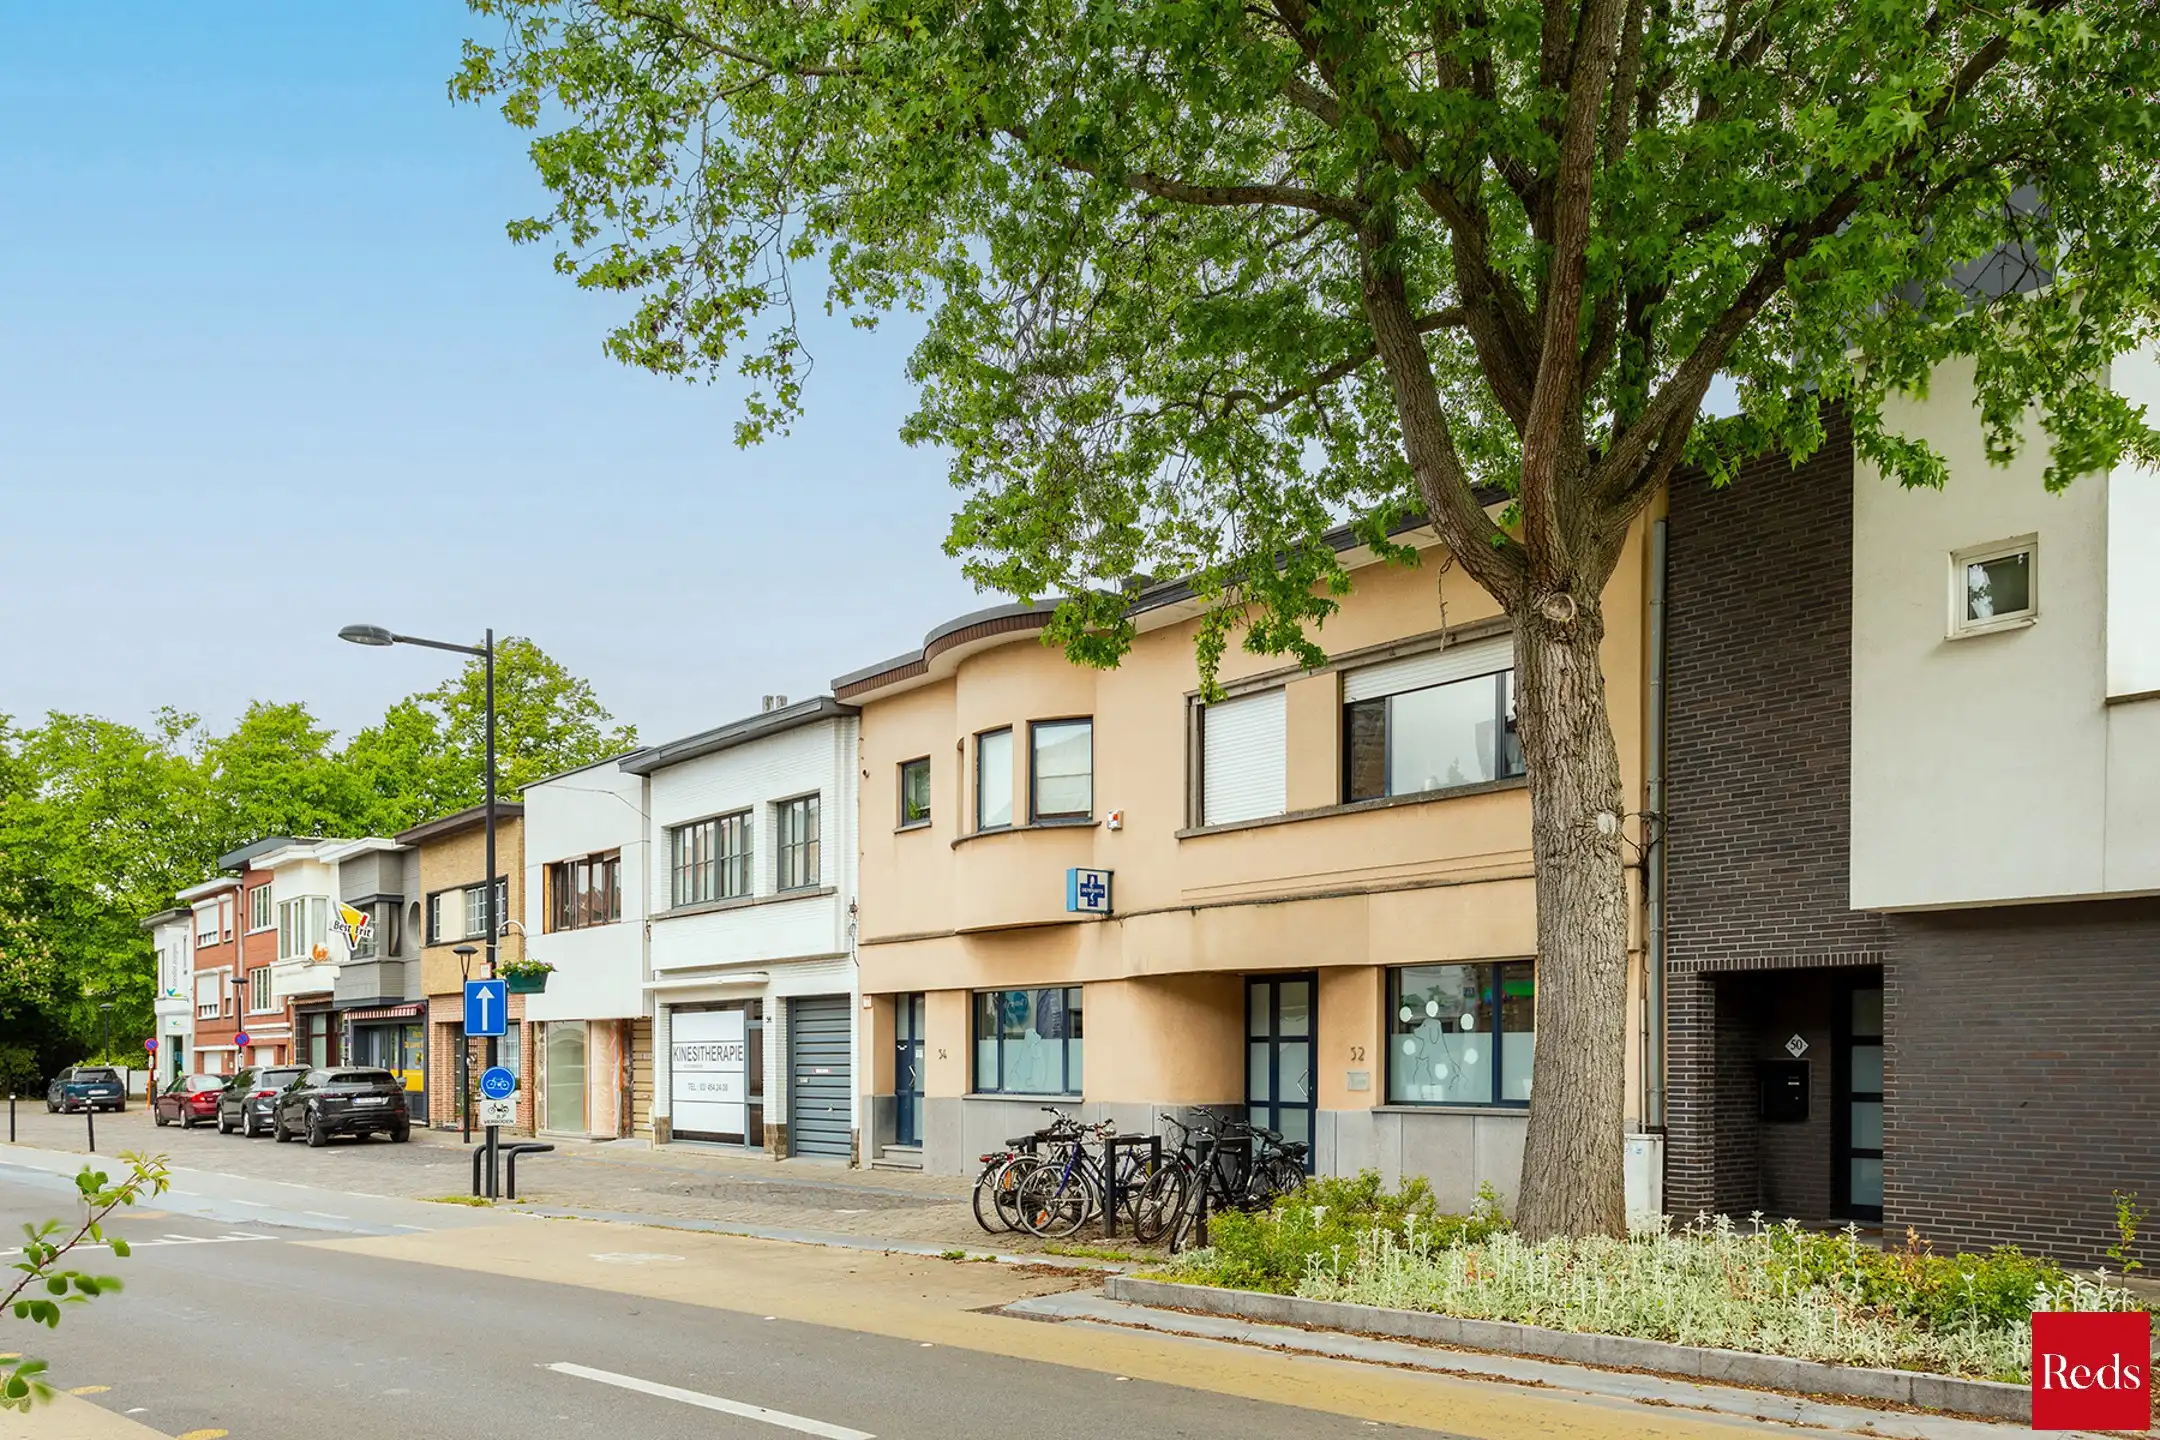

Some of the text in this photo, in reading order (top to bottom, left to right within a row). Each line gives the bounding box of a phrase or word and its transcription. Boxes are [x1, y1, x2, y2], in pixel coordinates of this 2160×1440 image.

[333, 920, 351, 933] Best
[1790, 1039, 1803, 1051] 50
[673, 1044, 743, 1062] KINESITHERAPIE
[1350, 1046, 1365, 1062] 52
